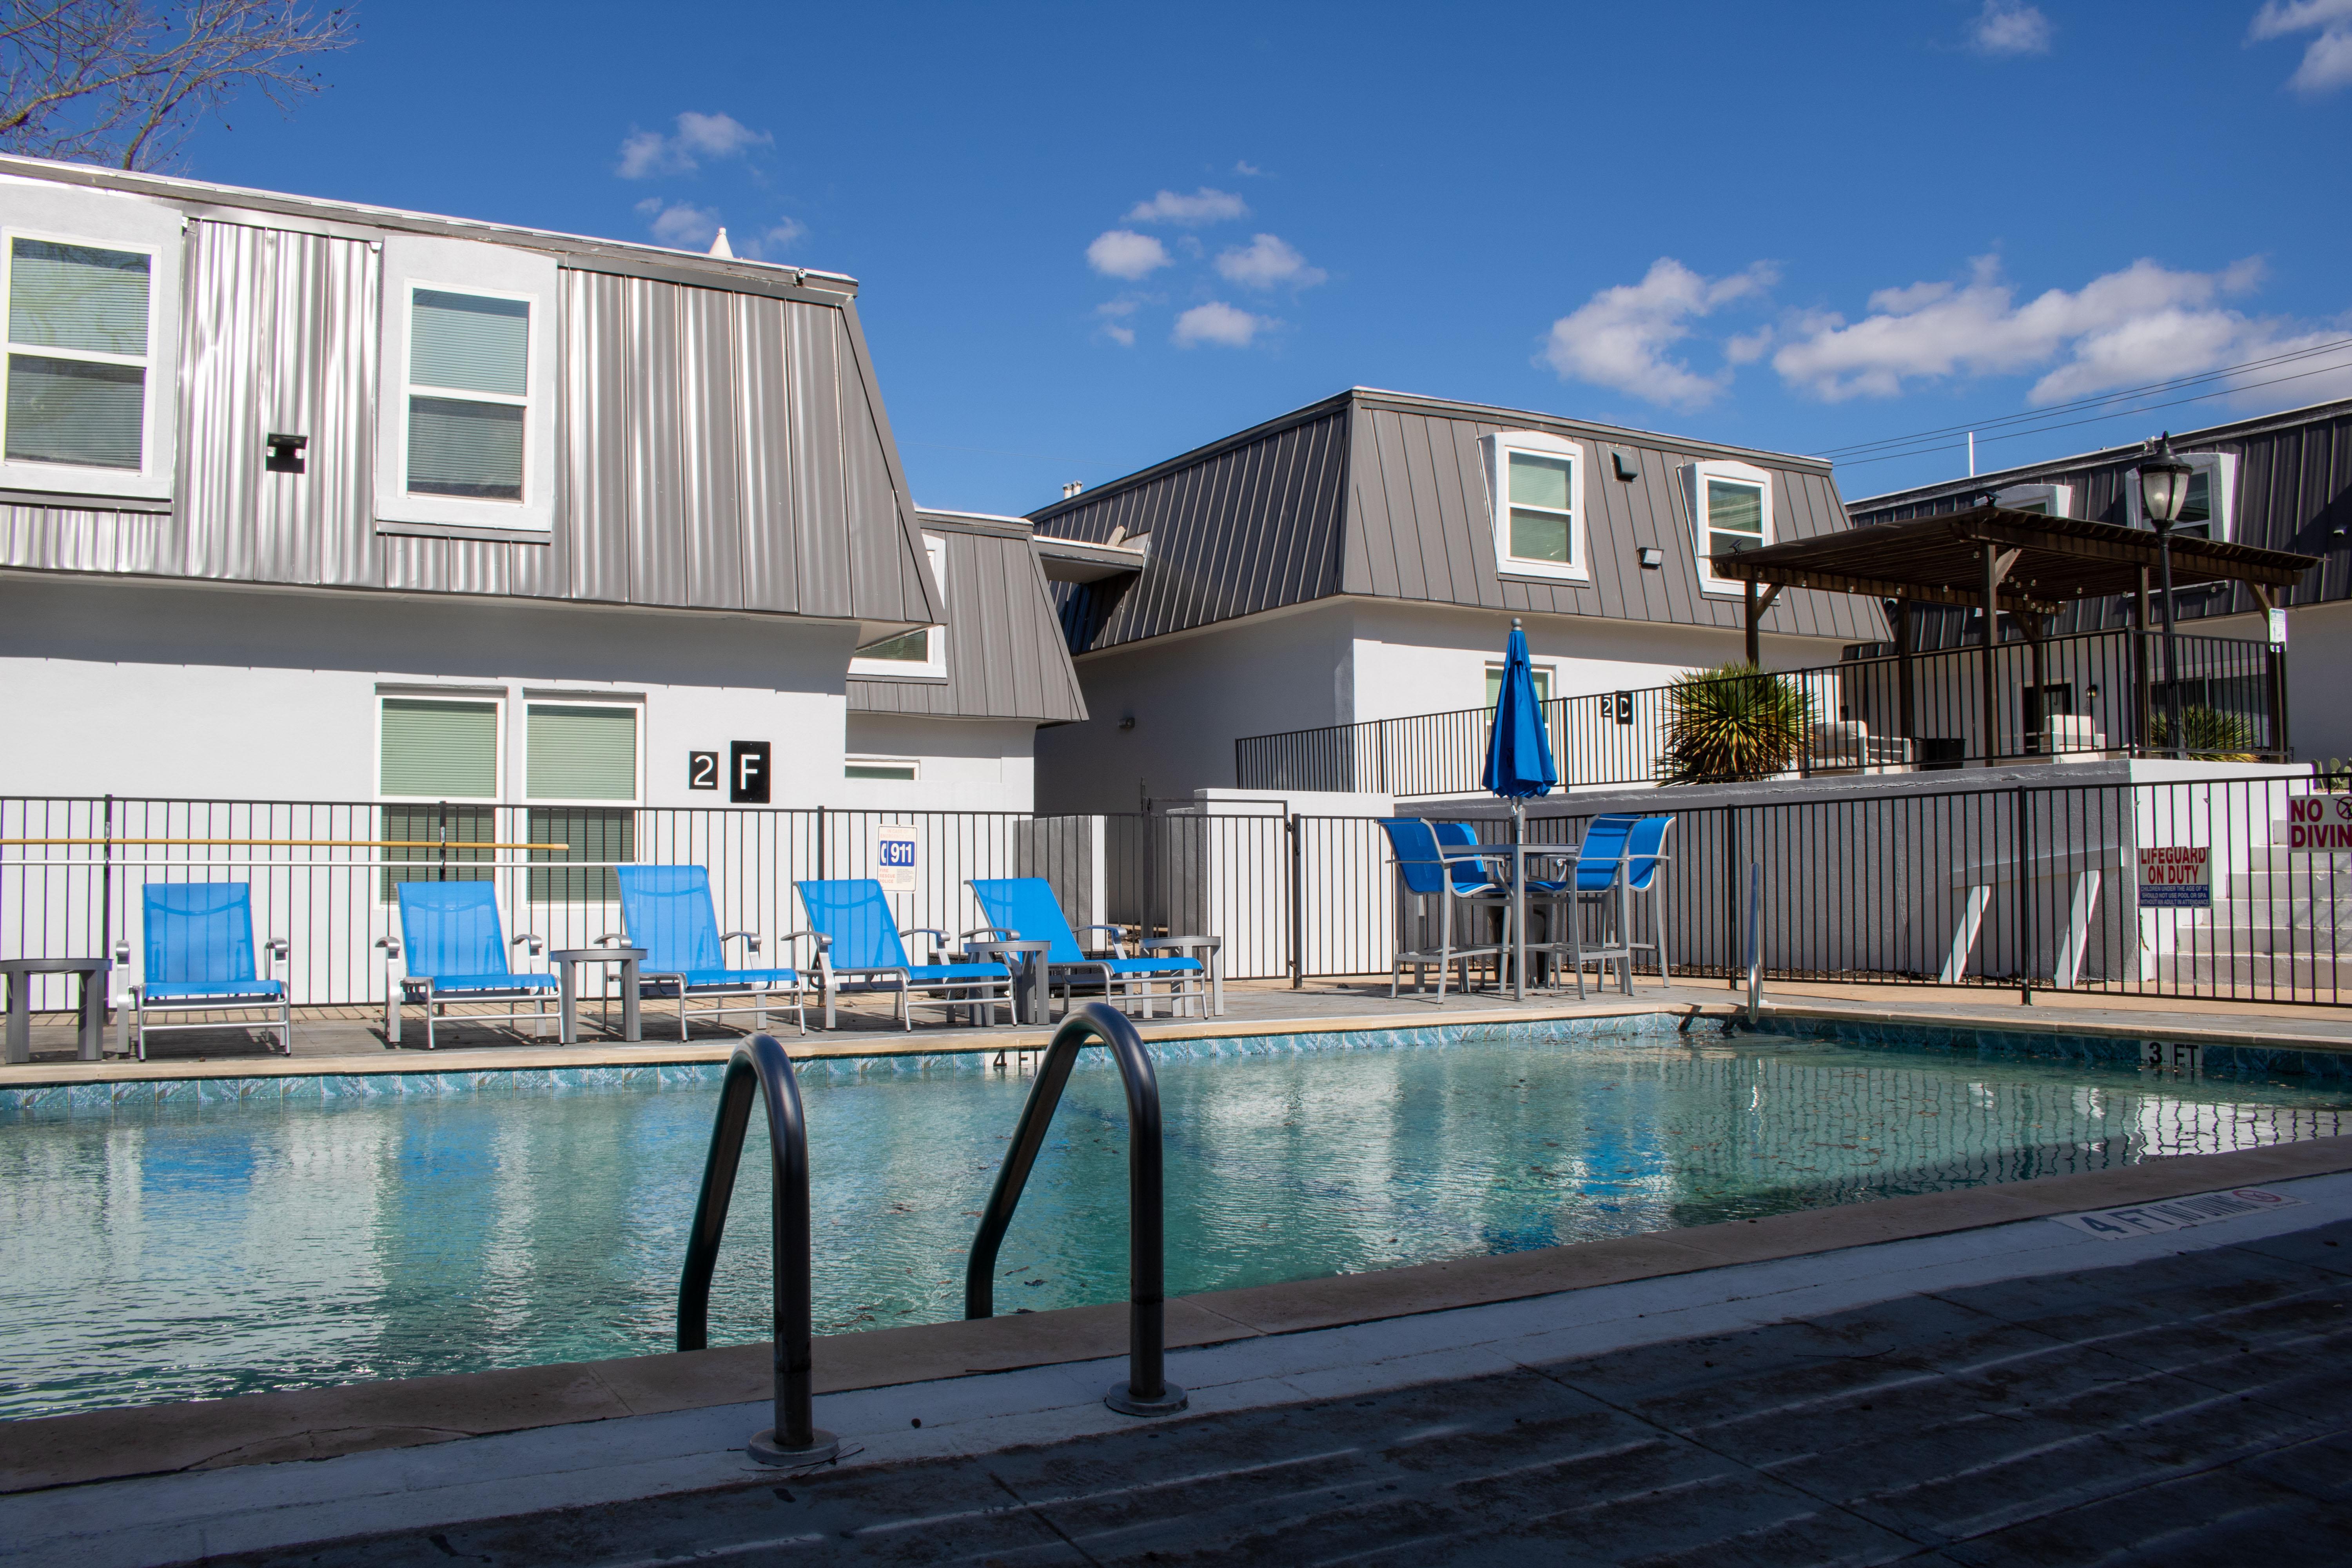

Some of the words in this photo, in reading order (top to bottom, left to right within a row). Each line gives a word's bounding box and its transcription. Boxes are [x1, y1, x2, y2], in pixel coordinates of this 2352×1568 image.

[1603, 698, 1611, 716] 2
[1620, 697, 1629, 717] D
[694, 755, 713, 786] 2
[741, 754, 760, 789] F
[2290, 799, 2323, 822] NO
[2291, 824, 2352, 848] DIVIN
[891, 843, 912, 862] 911
[2141, 847, 2206, 864] LIFEGUARD
[2148, 865, 2164, 884] ON
[2168, 865, 2199, 884] DUTY
[993, 1049, 1007, 1067] 4
[1018, 1047, 1042, 1066] FT
[2149, 1042, 2163, 1064] 3
[2174, 1044, 2199, 1069] FT
[2147, 1204, 2206, 1221] NO
[2174, 1195, 2259, 1216] DIVING
[2080, 1216, 2129, 1233] 4
[2105, 1209, 2176, 1229] FT
